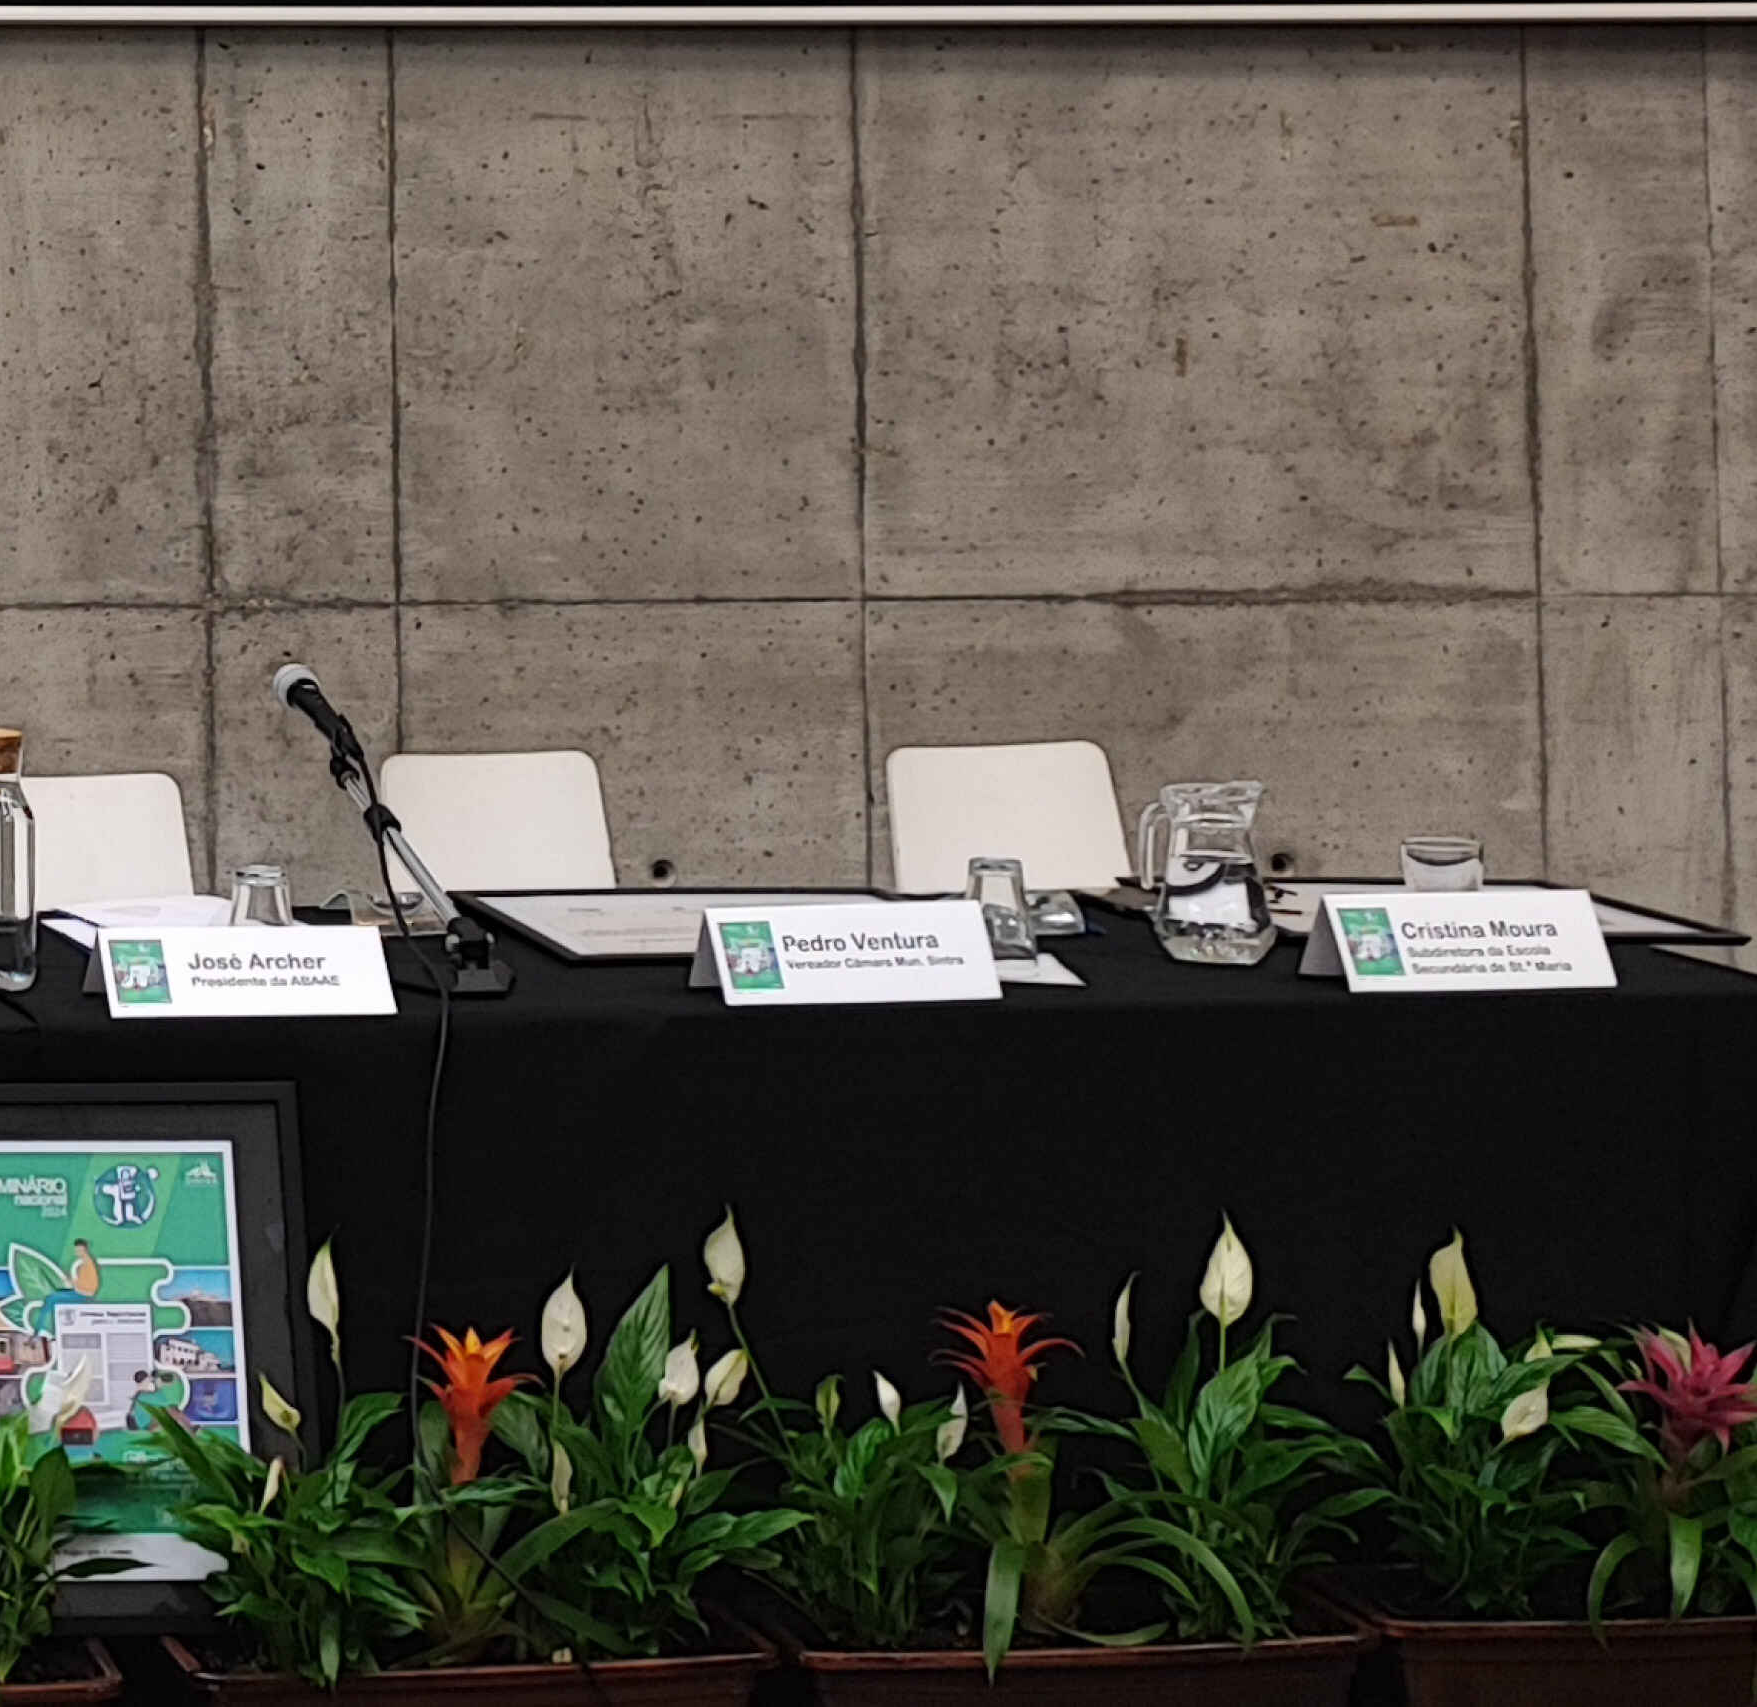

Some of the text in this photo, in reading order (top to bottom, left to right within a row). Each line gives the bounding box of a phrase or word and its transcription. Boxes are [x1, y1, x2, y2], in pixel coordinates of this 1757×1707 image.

[1400, 920, 1558, 940] Cristina Moura
[782, 931, 940, 953] Pedro Ventura
[187, 953, 326, 970] José Archer
[786, 959, 842, 970] Vereador
[926, 954, 965, 966] Sintra
[191, 976, 267, 987] Presidente
